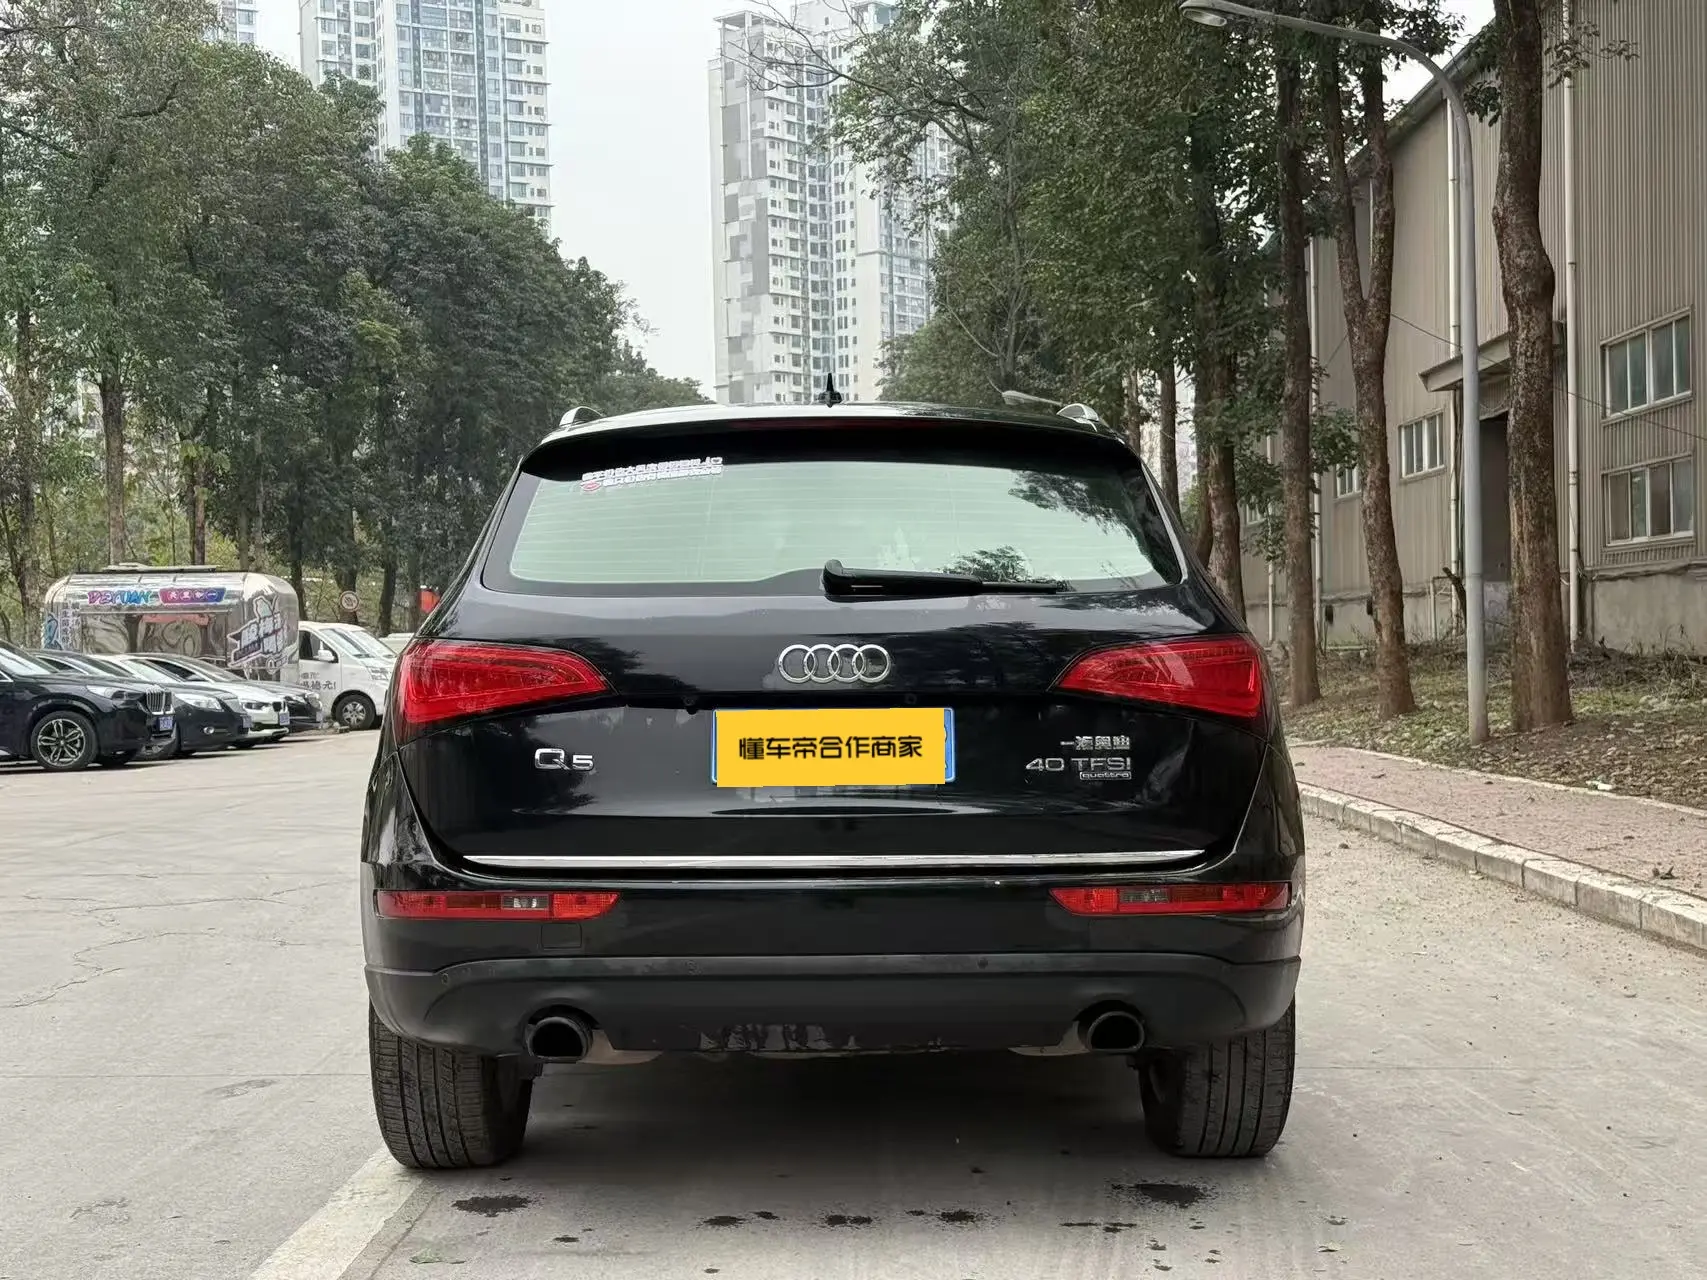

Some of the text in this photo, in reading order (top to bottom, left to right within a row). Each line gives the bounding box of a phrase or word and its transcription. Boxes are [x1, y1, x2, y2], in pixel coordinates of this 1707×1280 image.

[534, 748, 594, 771] Q5
[1026, 757, 1131, 772] 40 TFSI
[1081, 771, 1131, 779] quattro
